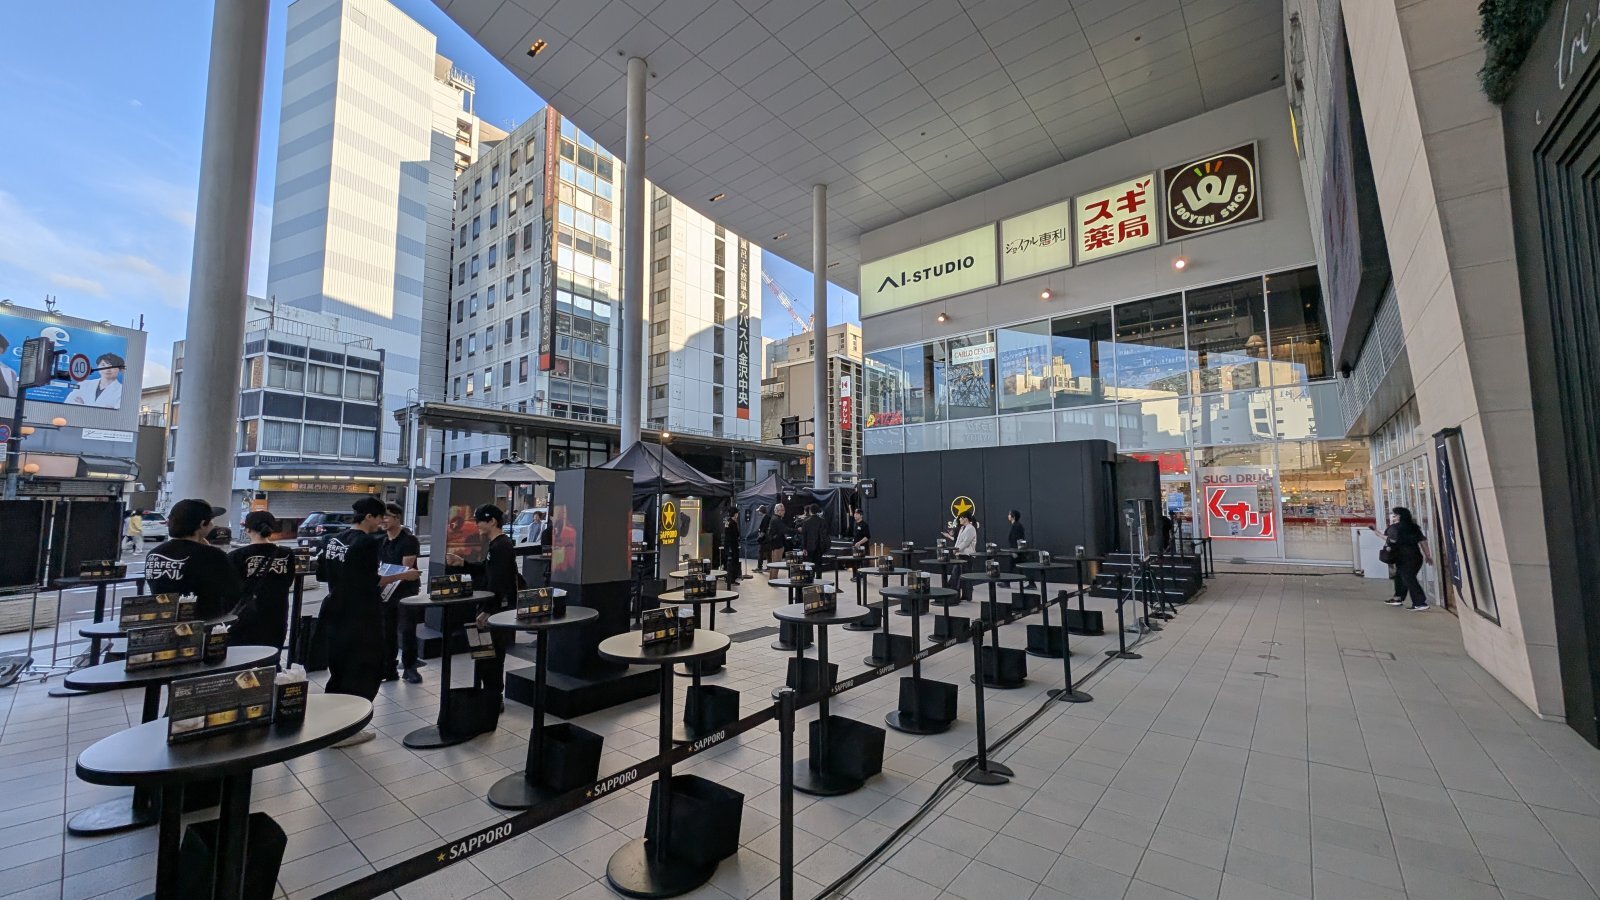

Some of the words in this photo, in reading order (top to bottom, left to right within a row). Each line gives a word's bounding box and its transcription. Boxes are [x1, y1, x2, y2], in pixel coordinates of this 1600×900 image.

[1084, 179, 1150, 225] スギ
[1174, 203, 1215, 225] 100YEN
[1220, 184, 1248, 218] SHOP
[1084, 215, 1149, 251] 薬局
[738, 301, 749, 405] アパスパ金沢中央
[954, 349, 973, 359] CARLO
[74, 361, 86, 374] 40
[1203, 474, 1232, 484] SUGI
[1236, 472, 1273, 483] DRUG
[1208, 488, 1273, 536] くすり
[660, 530, 678, 539] SAPPORO
[145, 568, 184, 580] 黒ラベル
[693, 730, 725, 752] SAPPORO
[594, 768, 638, 796] SAPPORO
[449, 823, 512, 859] SAPPORO
